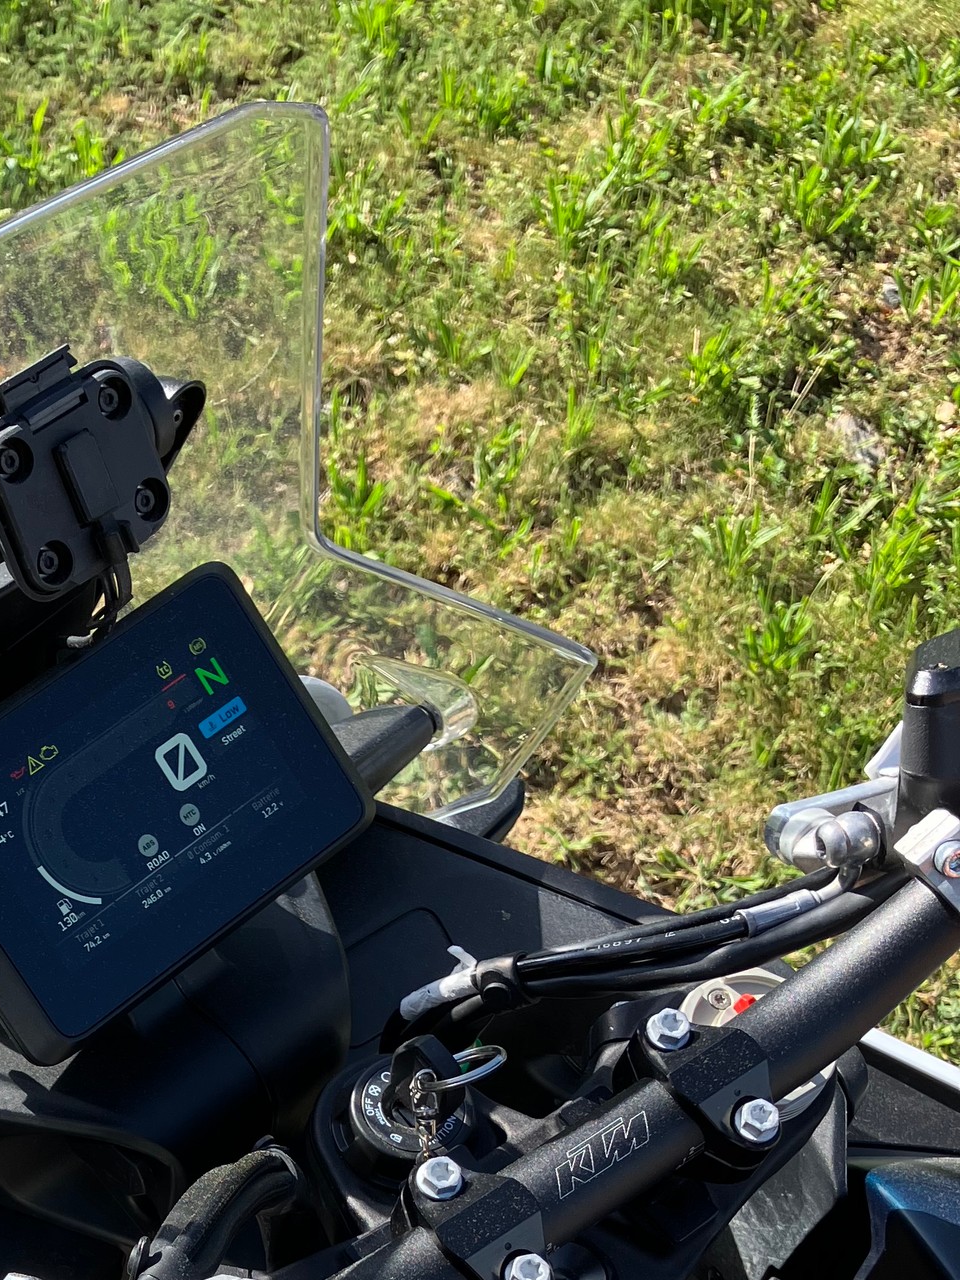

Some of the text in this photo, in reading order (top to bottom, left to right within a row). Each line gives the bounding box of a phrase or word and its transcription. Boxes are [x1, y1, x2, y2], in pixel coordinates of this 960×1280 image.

[194, 657, 230, 696] N
[221, 725, 246, 746] Street
[197, 774, 216, 789] km/h
[251, 787, 280, 812] Batterie
[183, 808, 197, 821] MTC
[261, 802, 279, 818] 12.2
[192, 823, 206, 836] ON
[142, 839, 156, 852] ABS
[146, 850, 170, 871] ROAD
[200, 852, 212, 864] 4.3
[135, 873, 165, 897] Trajet 2
[141, 889, 164, 908] 246.0
[74, 923, 97, 943] Trajet
[83, 935, 102, 953] 74.2
[365, 1097, 375, 1116] OFF
[555, 1110, 650, 1200] KTM
